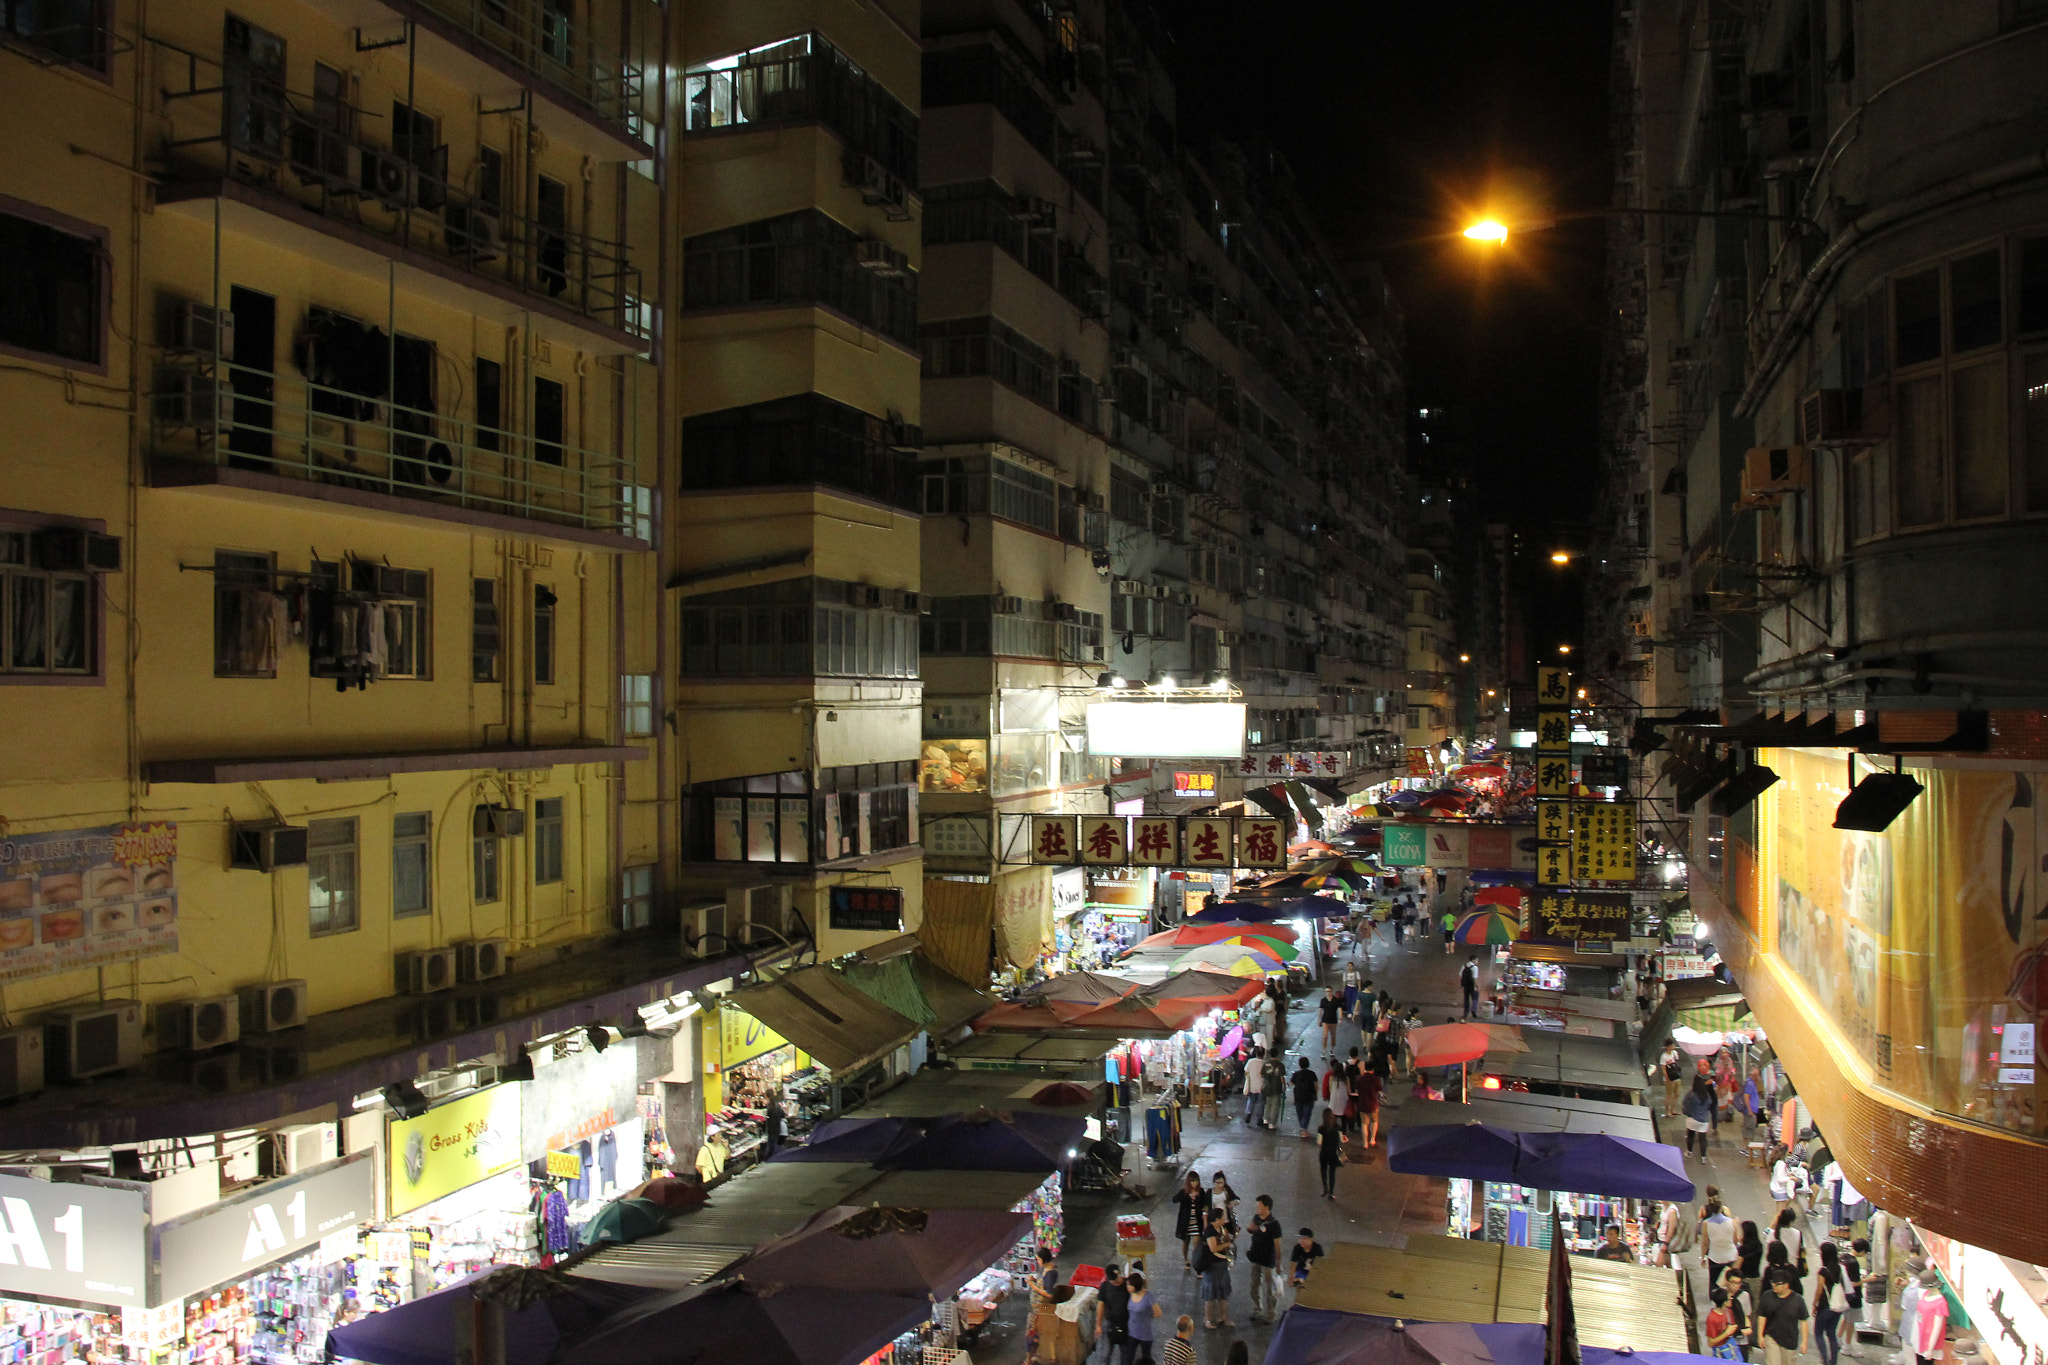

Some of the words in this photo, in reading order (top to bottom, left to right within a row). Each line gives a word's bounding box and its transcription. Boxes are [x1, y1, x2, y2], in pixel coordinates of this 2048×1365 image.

[1541, 672, 1567, 790] 馬維邦
[1389, 845, 1421, 859] LEONA
[430, 1133, 462, 1151] Grass
[464, 1119, 488, 1140] Kids
[241, 1190, 307, 1262] A1
